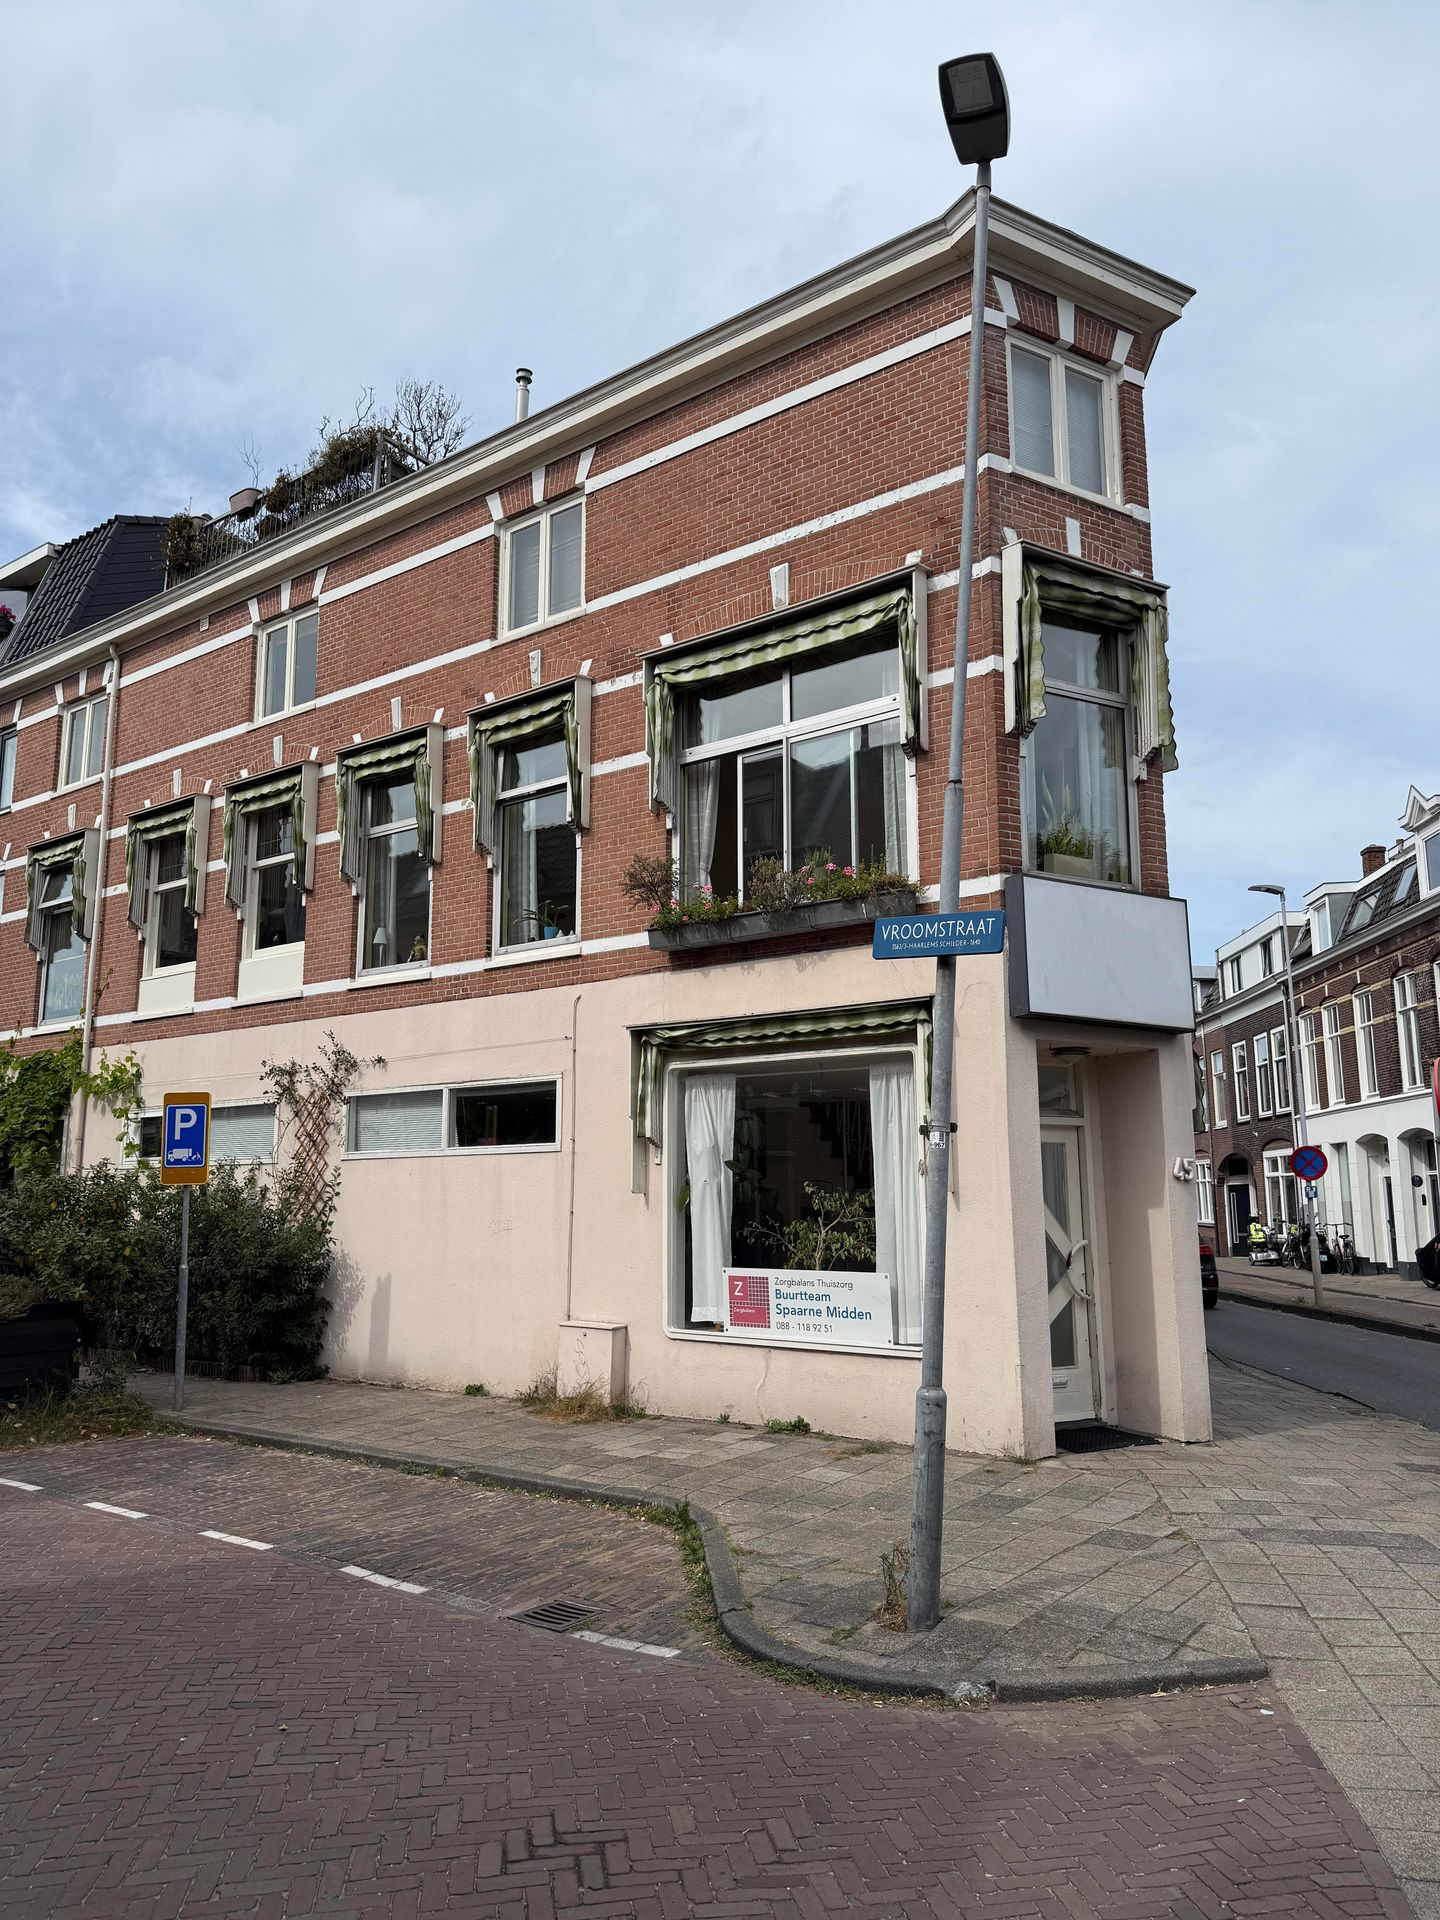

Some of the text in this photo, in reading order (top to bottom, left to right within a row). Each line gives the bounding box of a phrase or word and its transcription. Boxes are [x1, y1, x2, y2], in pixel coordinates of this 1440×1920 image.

[882, 918, 996, 940] VROOMSTRAAT
[174, 1108, 197, 1140] P
[1173, 1156, 1194, 1180] 45
[734, 1281, 744, 1296] Z
[774, 1277, 854, 1291] Zorgbalans Thuiszorg
[775, 1289, 831, 1302] Buurtteam
[775, 1303, 872, 1321] Spaarne Midden
[776, 1321, 790, 1330] 088
[797, 1323, 811, 1331] 118
[813, 1324, 822, 1332] 92
[824, 1325, 833, 1333] 51
